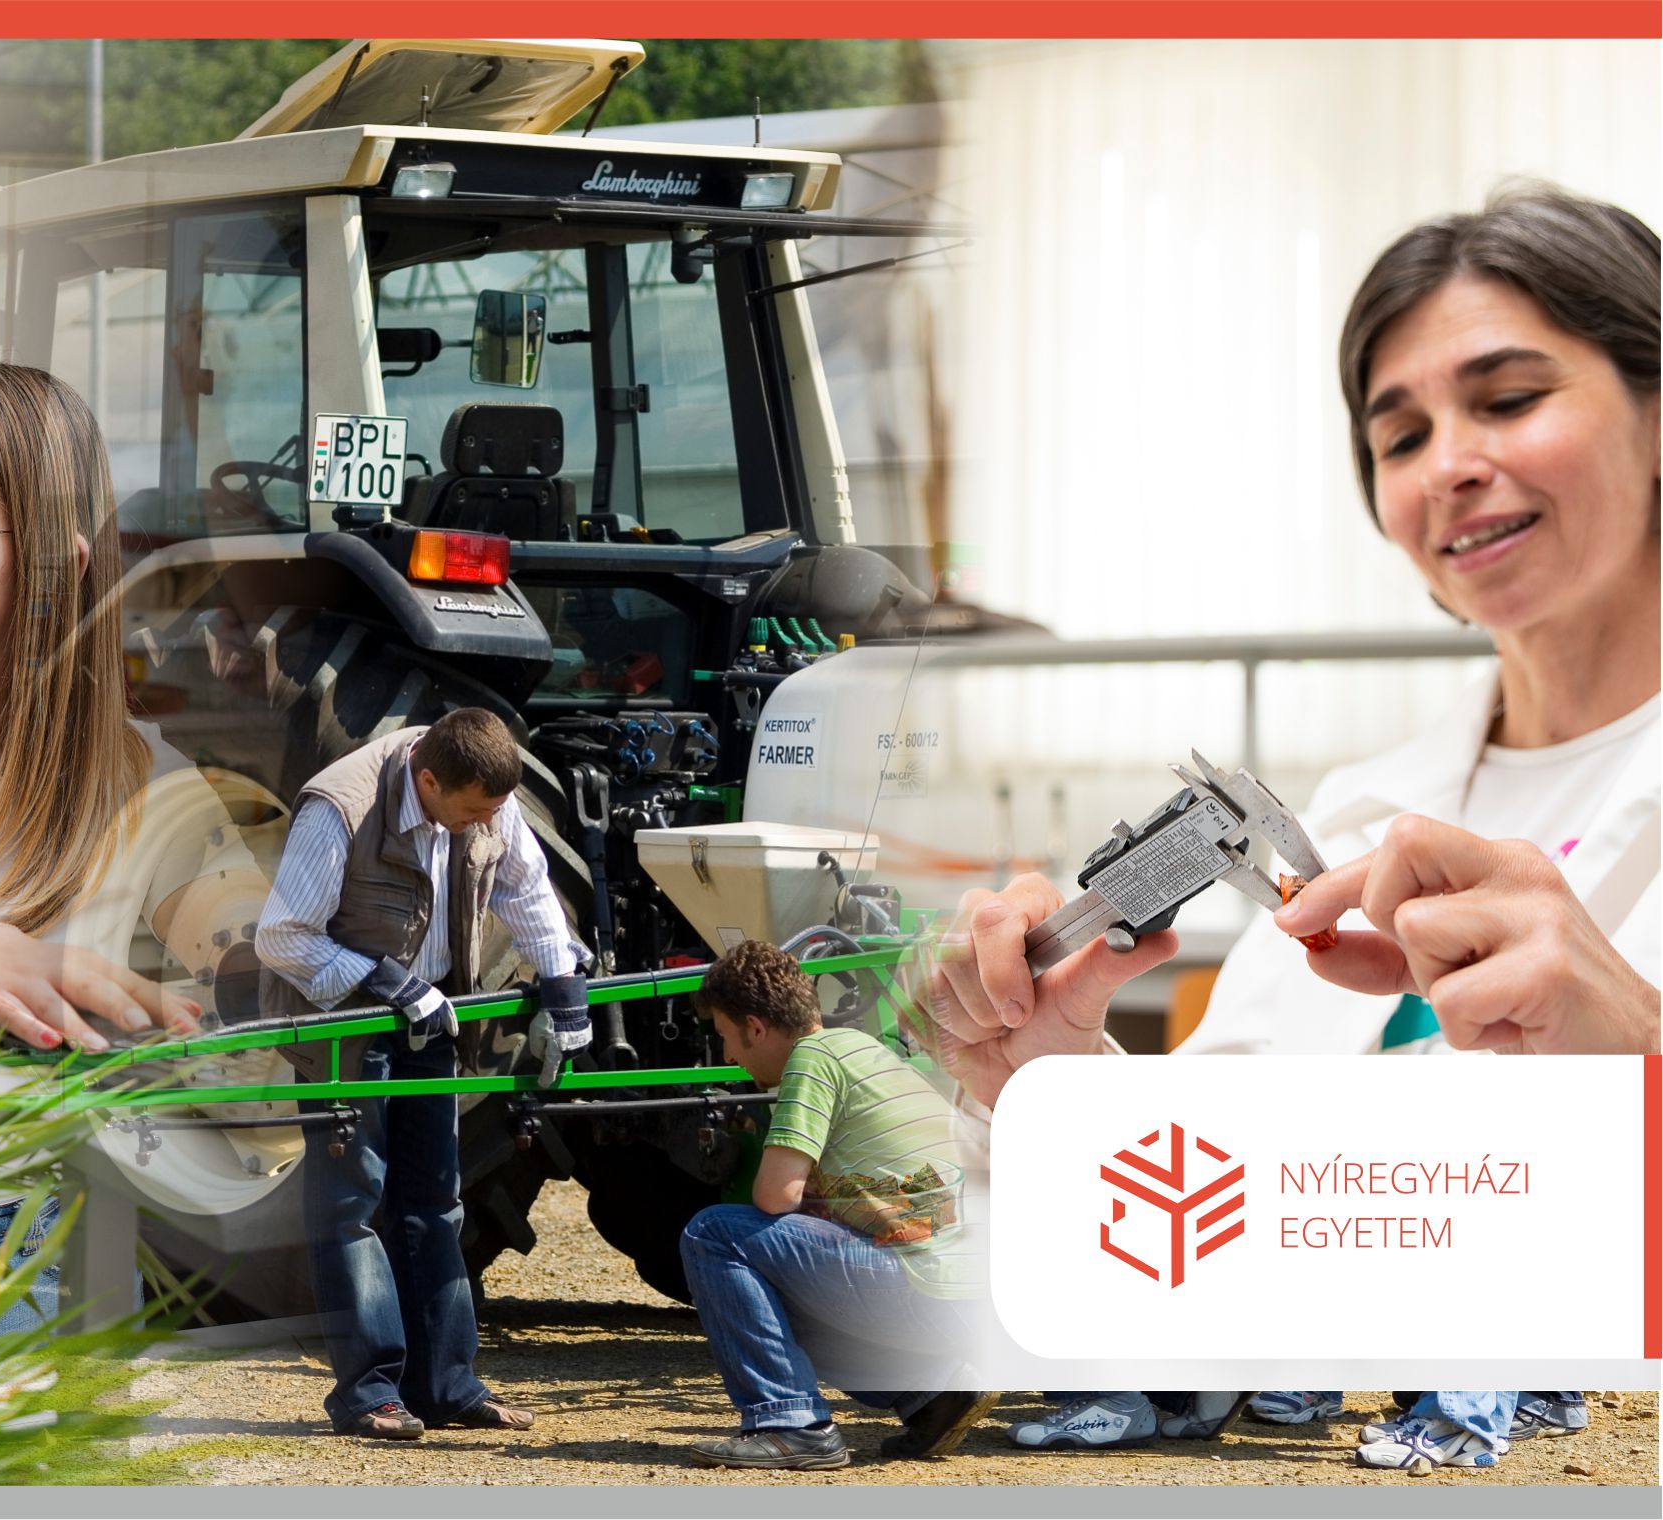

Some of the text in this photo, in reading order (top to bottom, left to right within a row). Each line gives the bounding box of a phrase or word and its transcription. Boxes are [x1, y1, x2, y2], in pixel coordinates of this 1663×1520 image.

[581, 160, 701, 199] Lamborghini
[334, 422, 401, 460] BPL
[314, 460, 327, 476] H
[342, 462, 395, 499] 100
[436, 596, 526, 618] Lamborghini
[905, 731, 939, 748] 600/12
[758, 745, 814, 765] FARMER
[1064, 1414, 1110, 1431] Cabin
